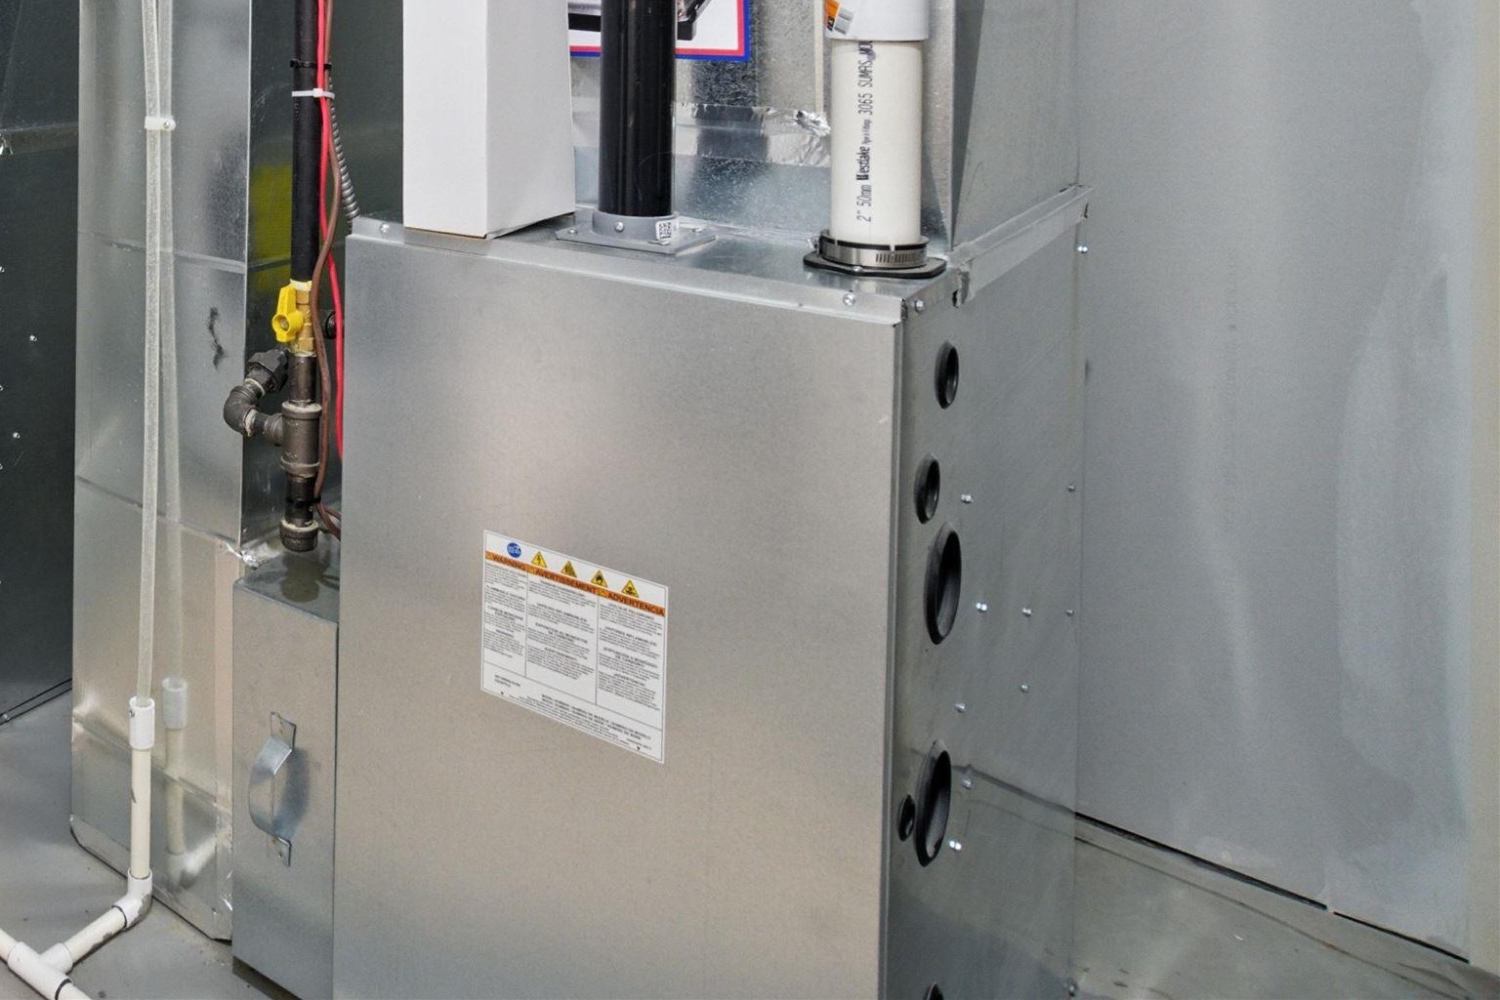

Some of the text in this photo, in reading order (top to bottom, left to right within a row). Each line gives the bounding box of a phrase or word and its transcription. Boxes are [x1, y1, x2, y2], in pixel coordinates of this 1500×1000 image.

[857, 60, 872, 87] SUMAS
[857, 92, 872, 115] 3065
[856, 145, 870, 180] Westlake
